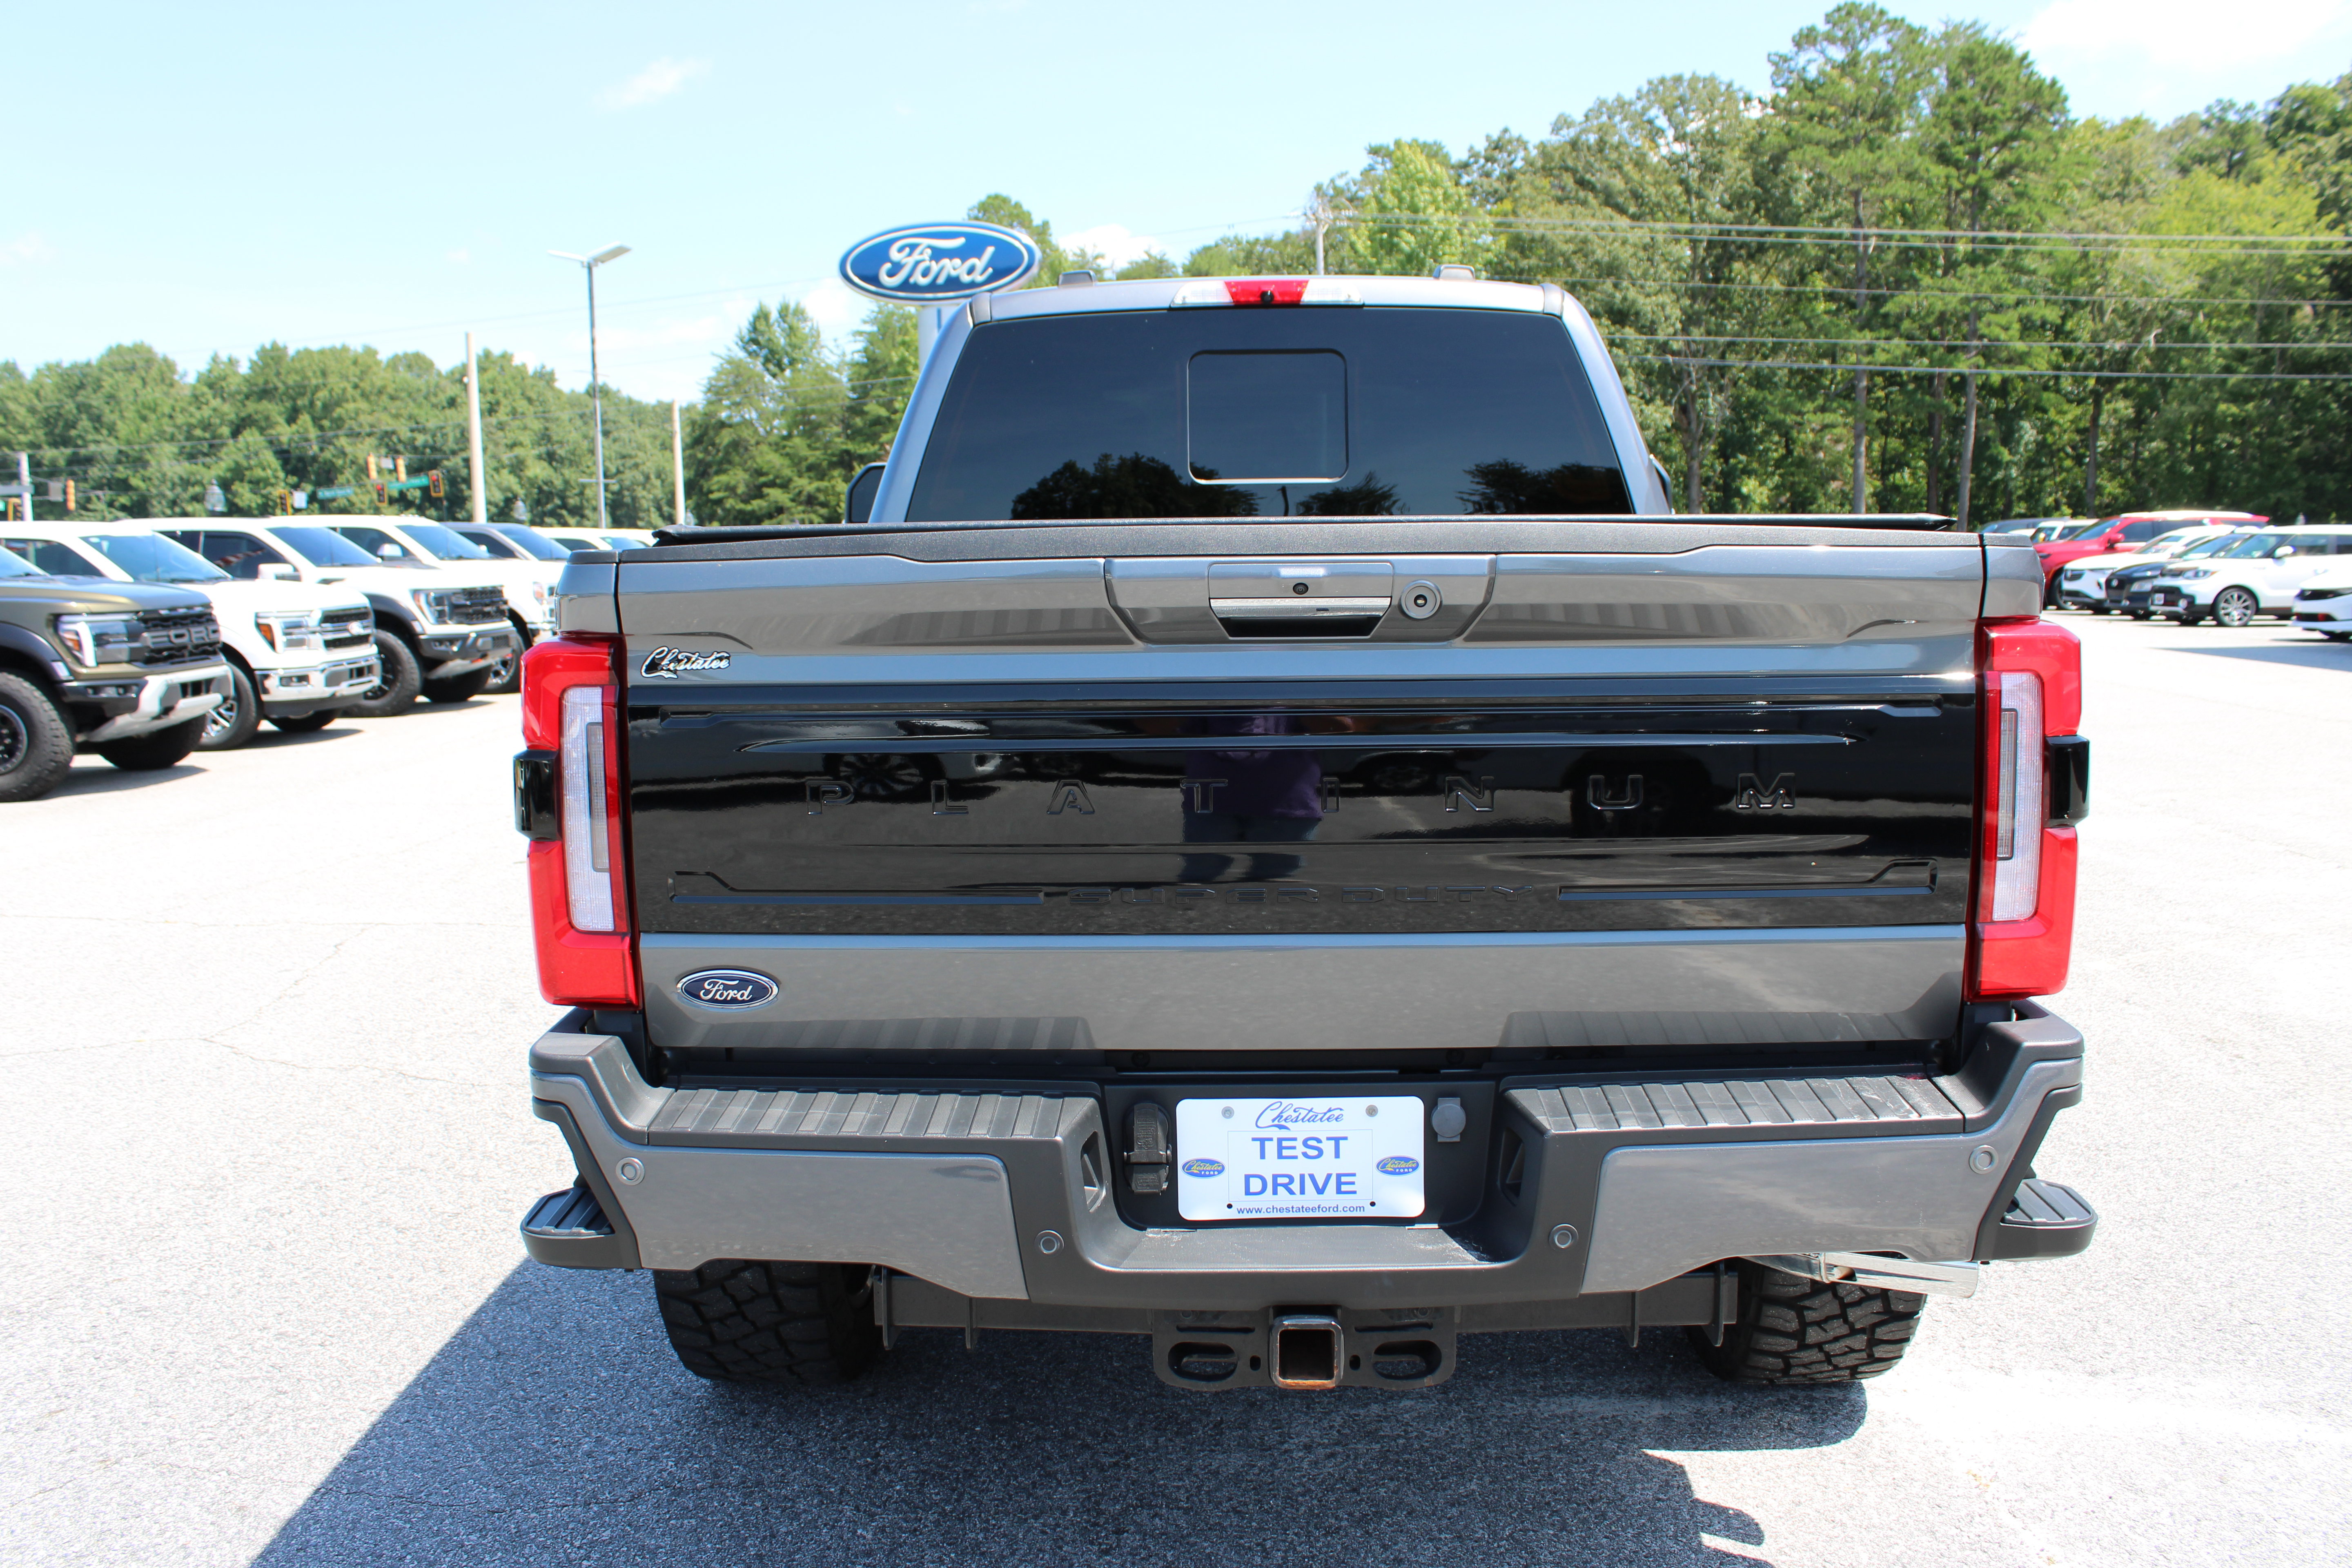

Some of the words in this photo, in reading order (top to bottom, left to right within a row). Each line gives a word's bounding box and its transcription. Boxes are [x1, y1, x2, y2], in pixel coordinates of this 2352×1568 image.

[879, 237, 996, 288] Ford
[641, 646, 731, 679] Chestatee
[806, 773, 1795, 815] PLATINUM
[1068, 887, 1319, 904] SUPER
[1342, 886, 1532, 903] DUTY
[699, 979, 753, 1000] Ford
[1255, 1101, 1345, 1130] Chestatee
[1251, 1136, 1348, 1160] TEST
[1184, 1160, 1222, 1173] Chestatee
[1379, 1158, 1417, 1171] Chestatee
[1244, 1172, 1357, 1196] DRIVE
[1236, 1204, 1365, 1214] www.chestateeford.com
